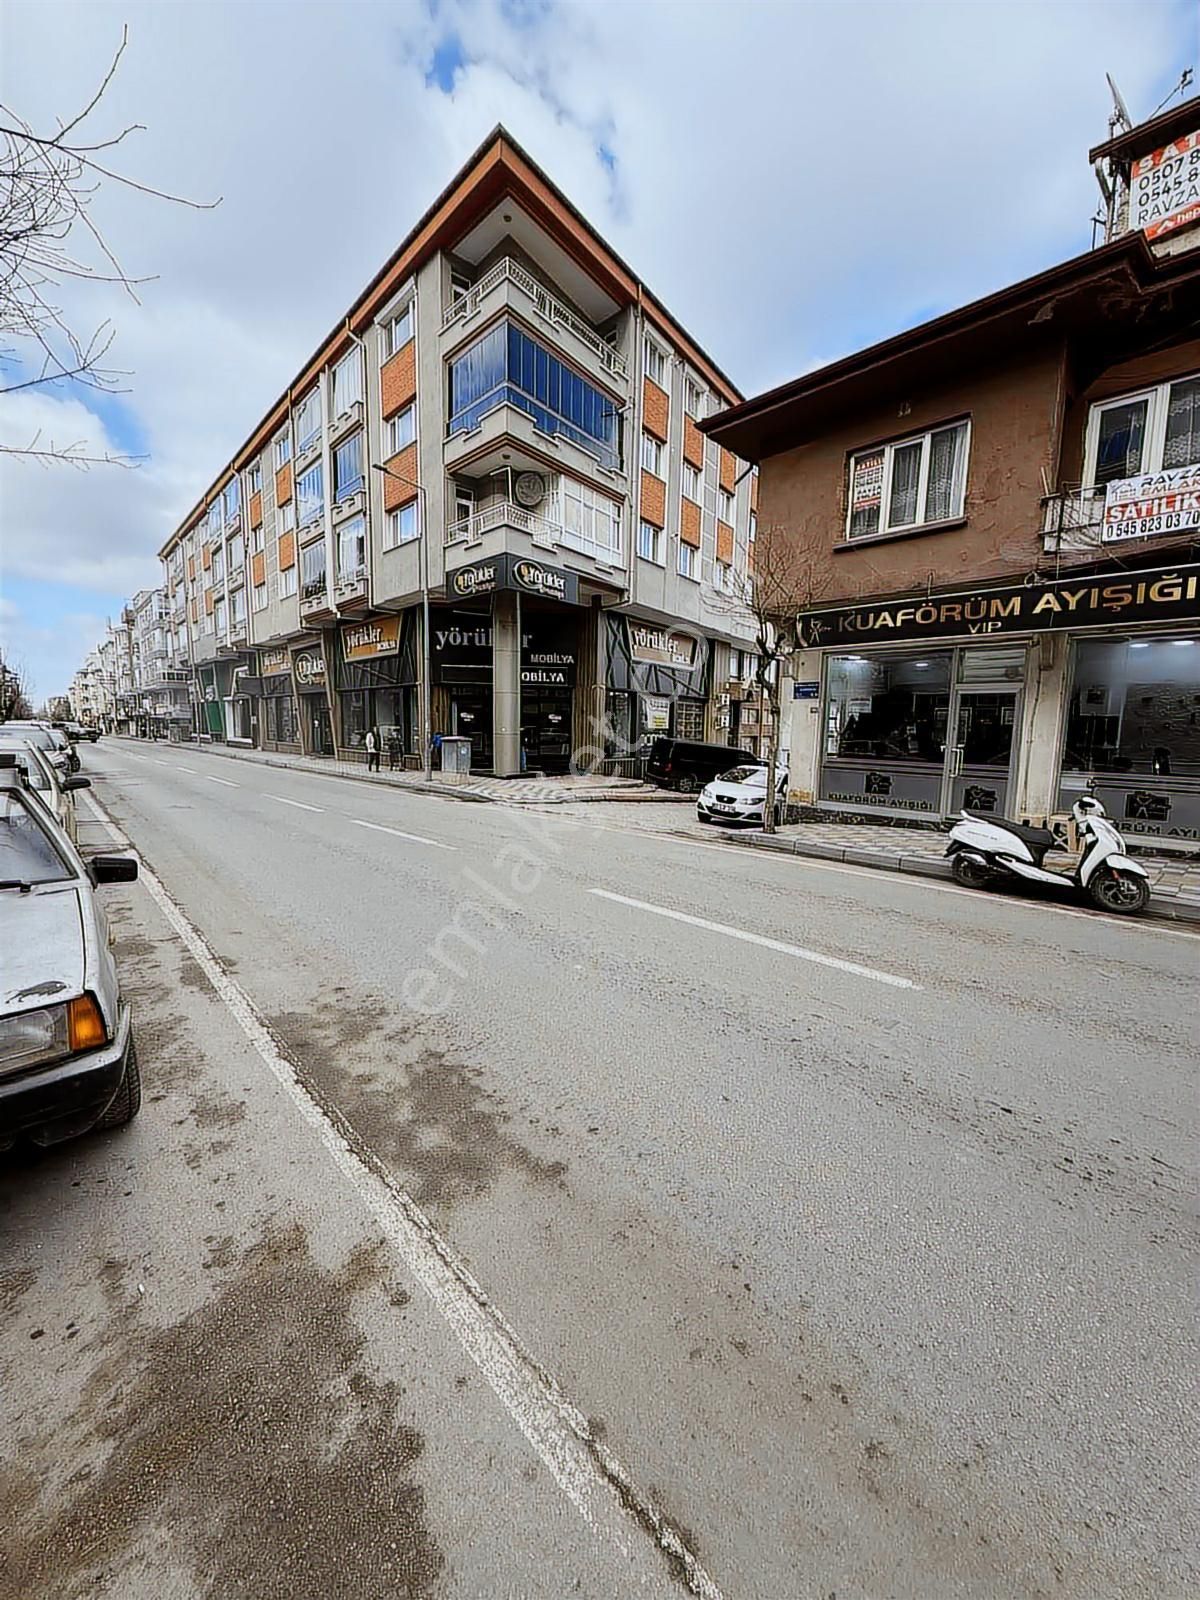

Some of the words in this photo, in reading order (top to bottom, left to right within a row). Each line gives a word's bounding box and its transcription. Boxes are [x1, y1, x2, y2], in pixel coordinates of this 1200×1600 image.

[1139, 157, 1184, 191] 0507
[1138, 175, 1183, 207] 0545
[1138, 184, 1199, 225] RAVZA
[1110, 492, 1200, 523] SATILIK
[1116, 520, 1137, 537] 545
[1140, 516, 1161, 533] 823
[1165, 513, 1181, 528] 03
[839, 596, 1021, 632] KUAFÖRÜM
[1032, 573, 1196, 615] AYIŞIĞI
[968, 621, 1002, 633] VIP
[530, 652, 575, 664] MOBİLYA
[521, 670, 565, 683] OBİLYA
